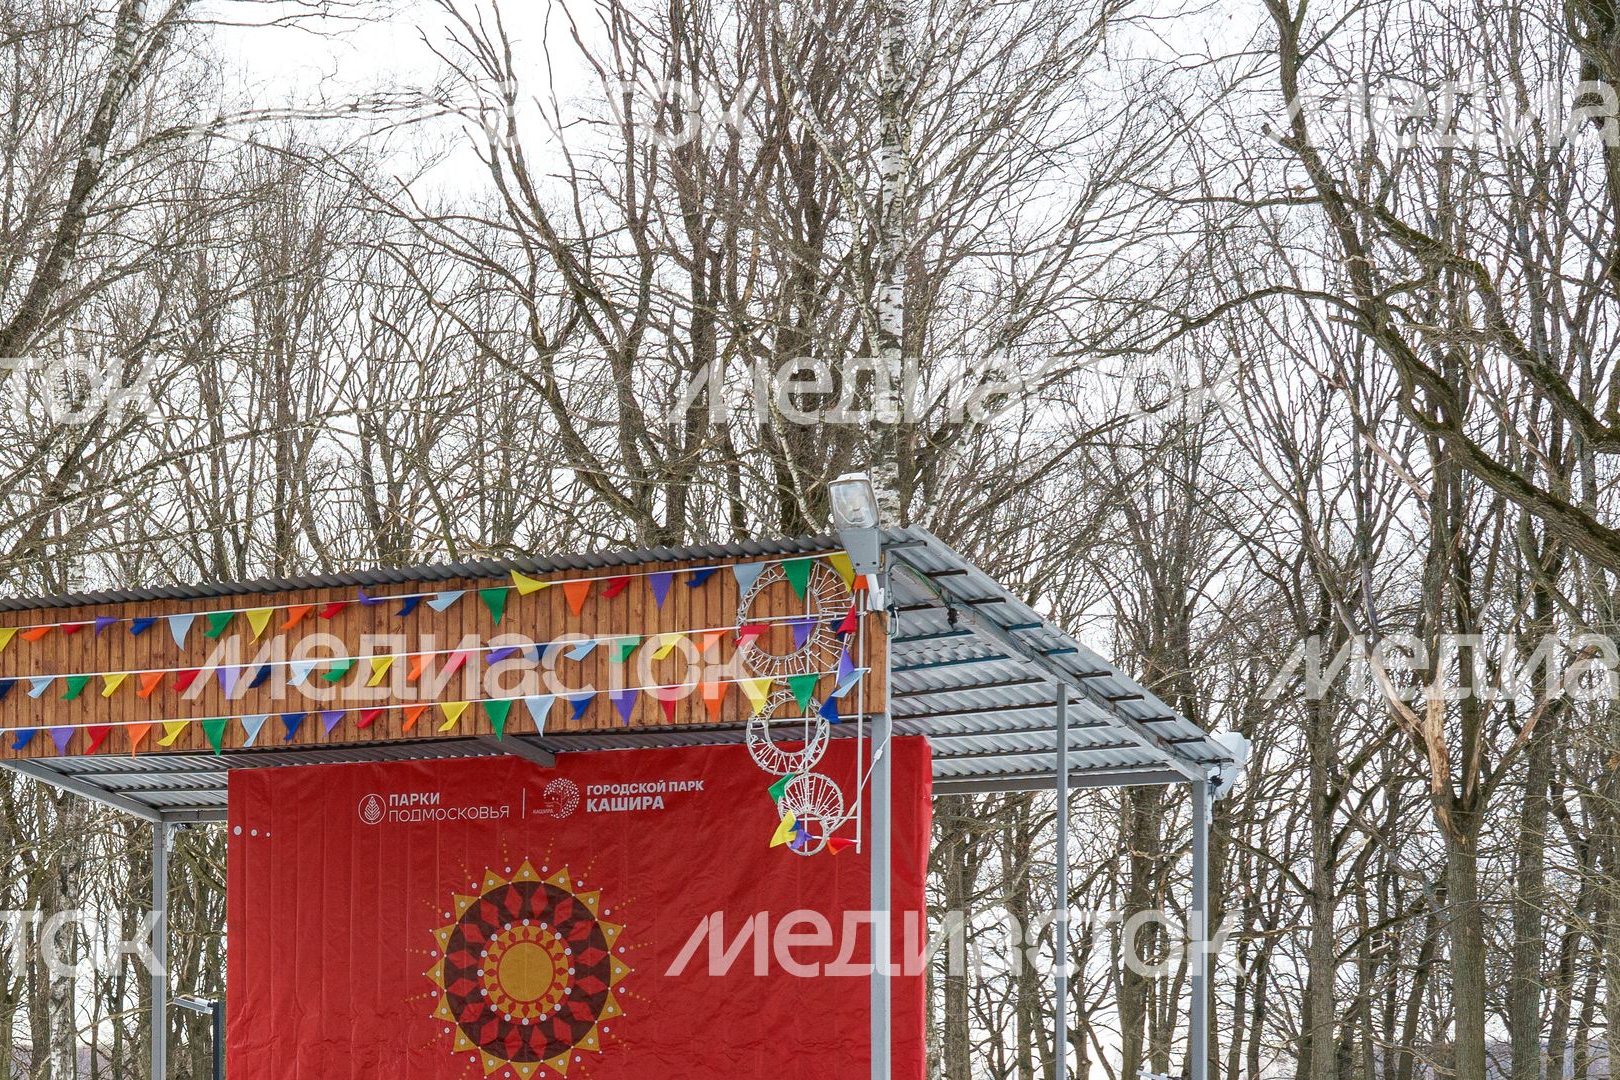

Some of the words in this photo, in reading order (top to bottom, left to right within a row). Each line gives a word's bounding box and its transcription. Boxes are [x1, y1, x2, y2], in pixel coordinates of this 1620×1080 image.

[586, 780, 666, 796] ГОРОДСКОЙ
[668, 780, 704, 793] ПАРК
[389, 792, 440, 807] ПАРКИ
[586, 796, 665, 813] КАШИРА
[388, 805, 510, 822] ПОДМОСКОВЬЯ
